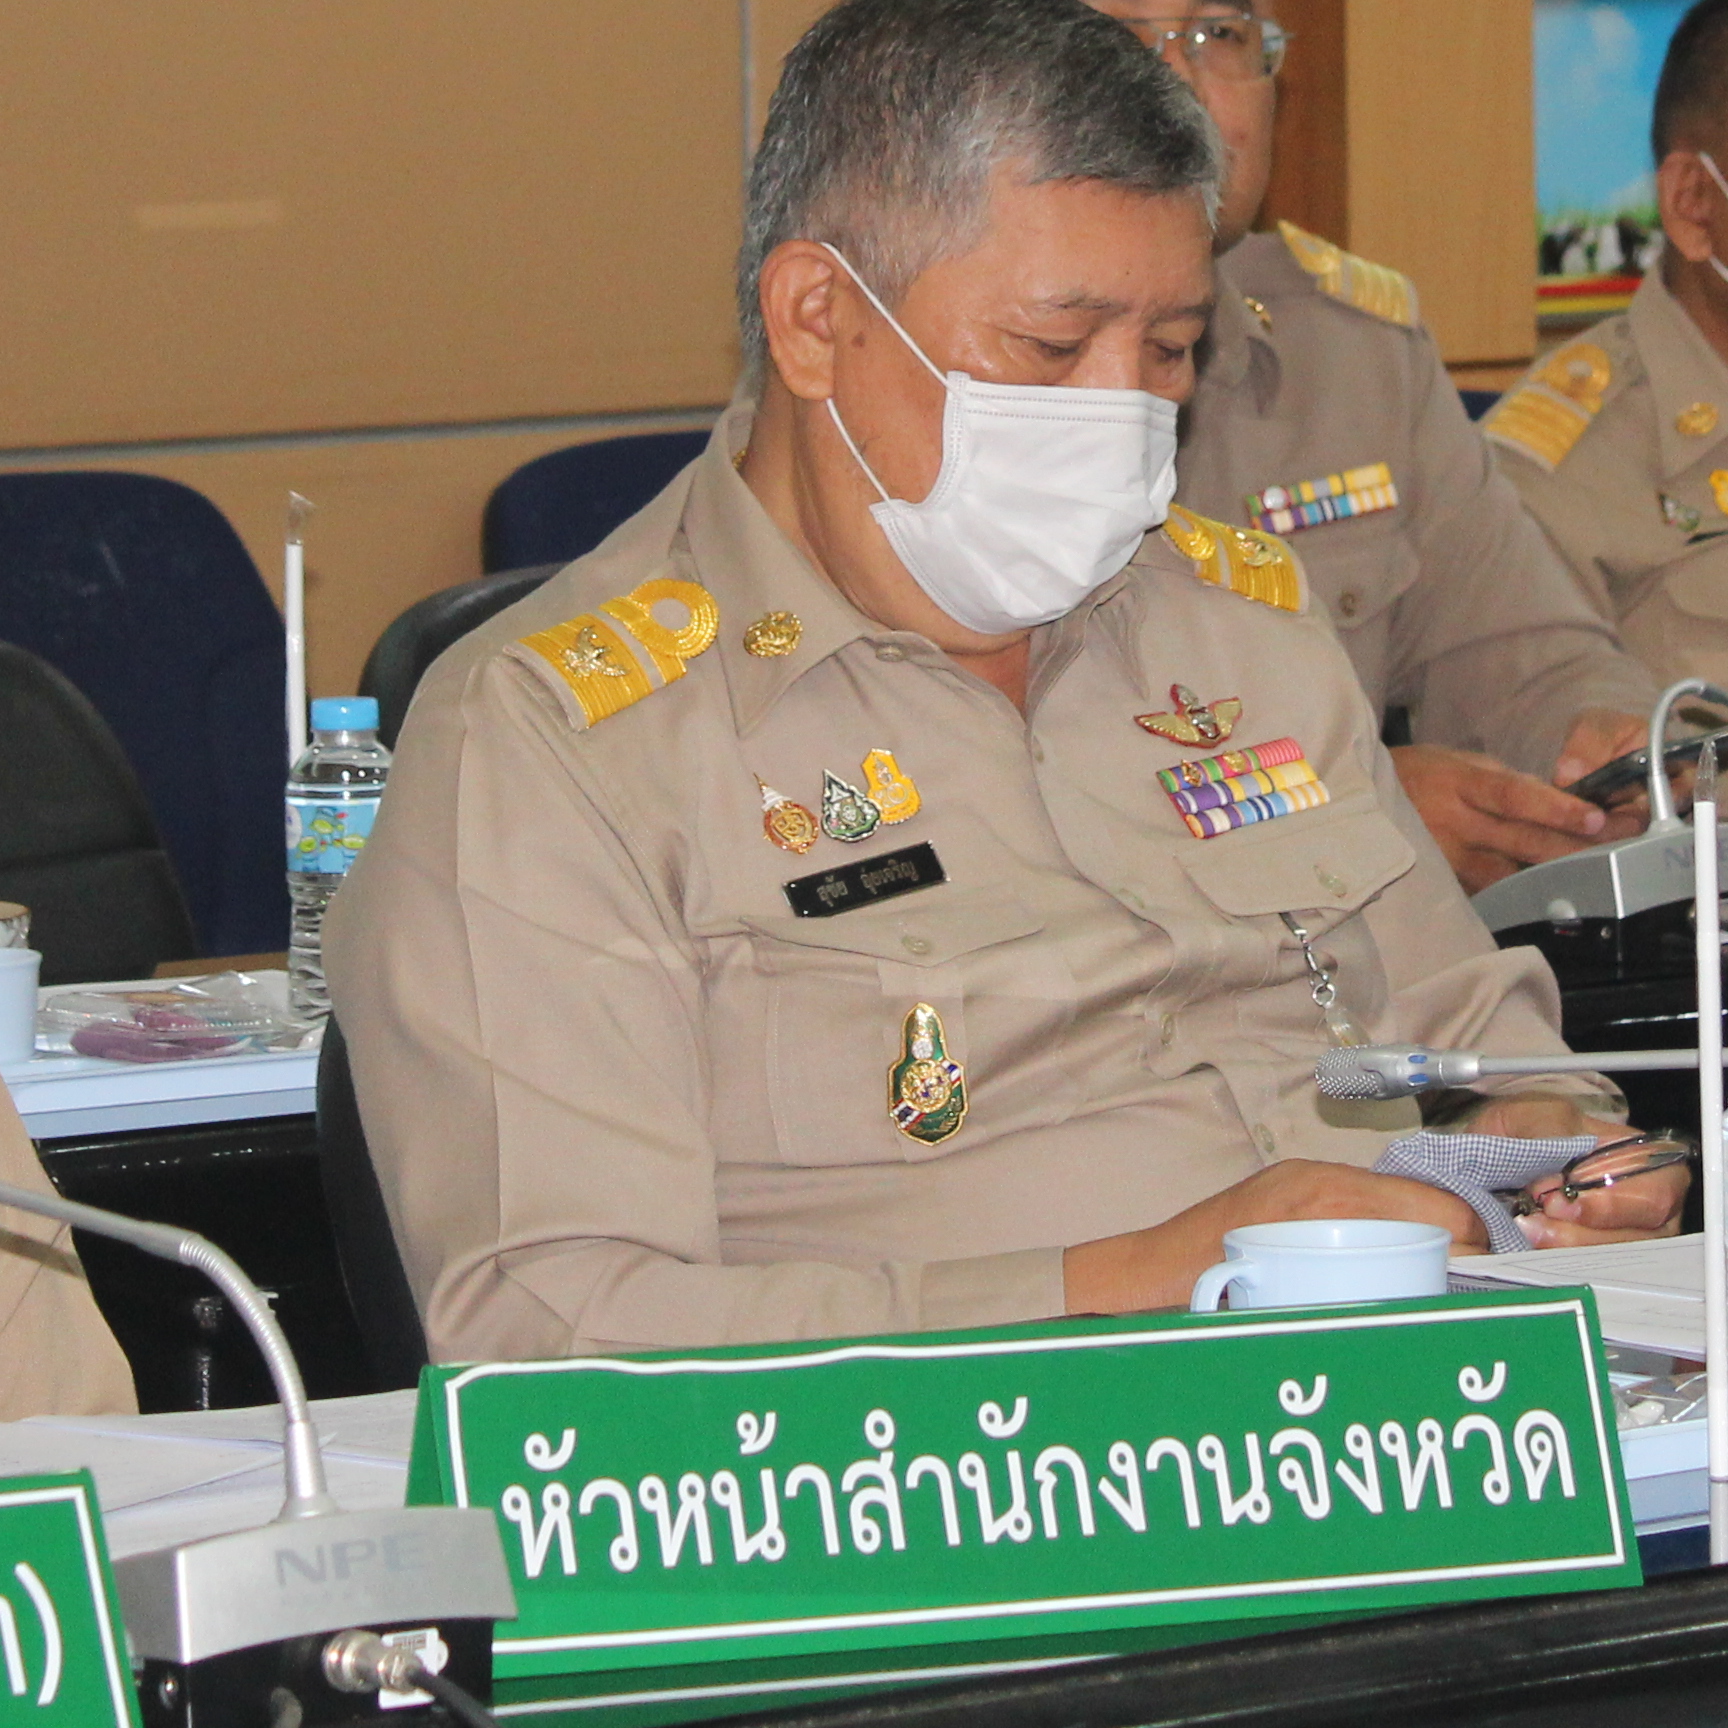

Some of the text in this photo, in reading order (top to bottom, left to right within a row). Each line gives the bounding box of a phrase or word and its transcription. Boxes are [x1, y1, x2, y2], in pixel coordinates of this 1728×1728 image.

[501, 1361, 1577, 1579] หัวหน้าสำนักงานจังหวัด
[275, 1530, 422, 1585] NPE
